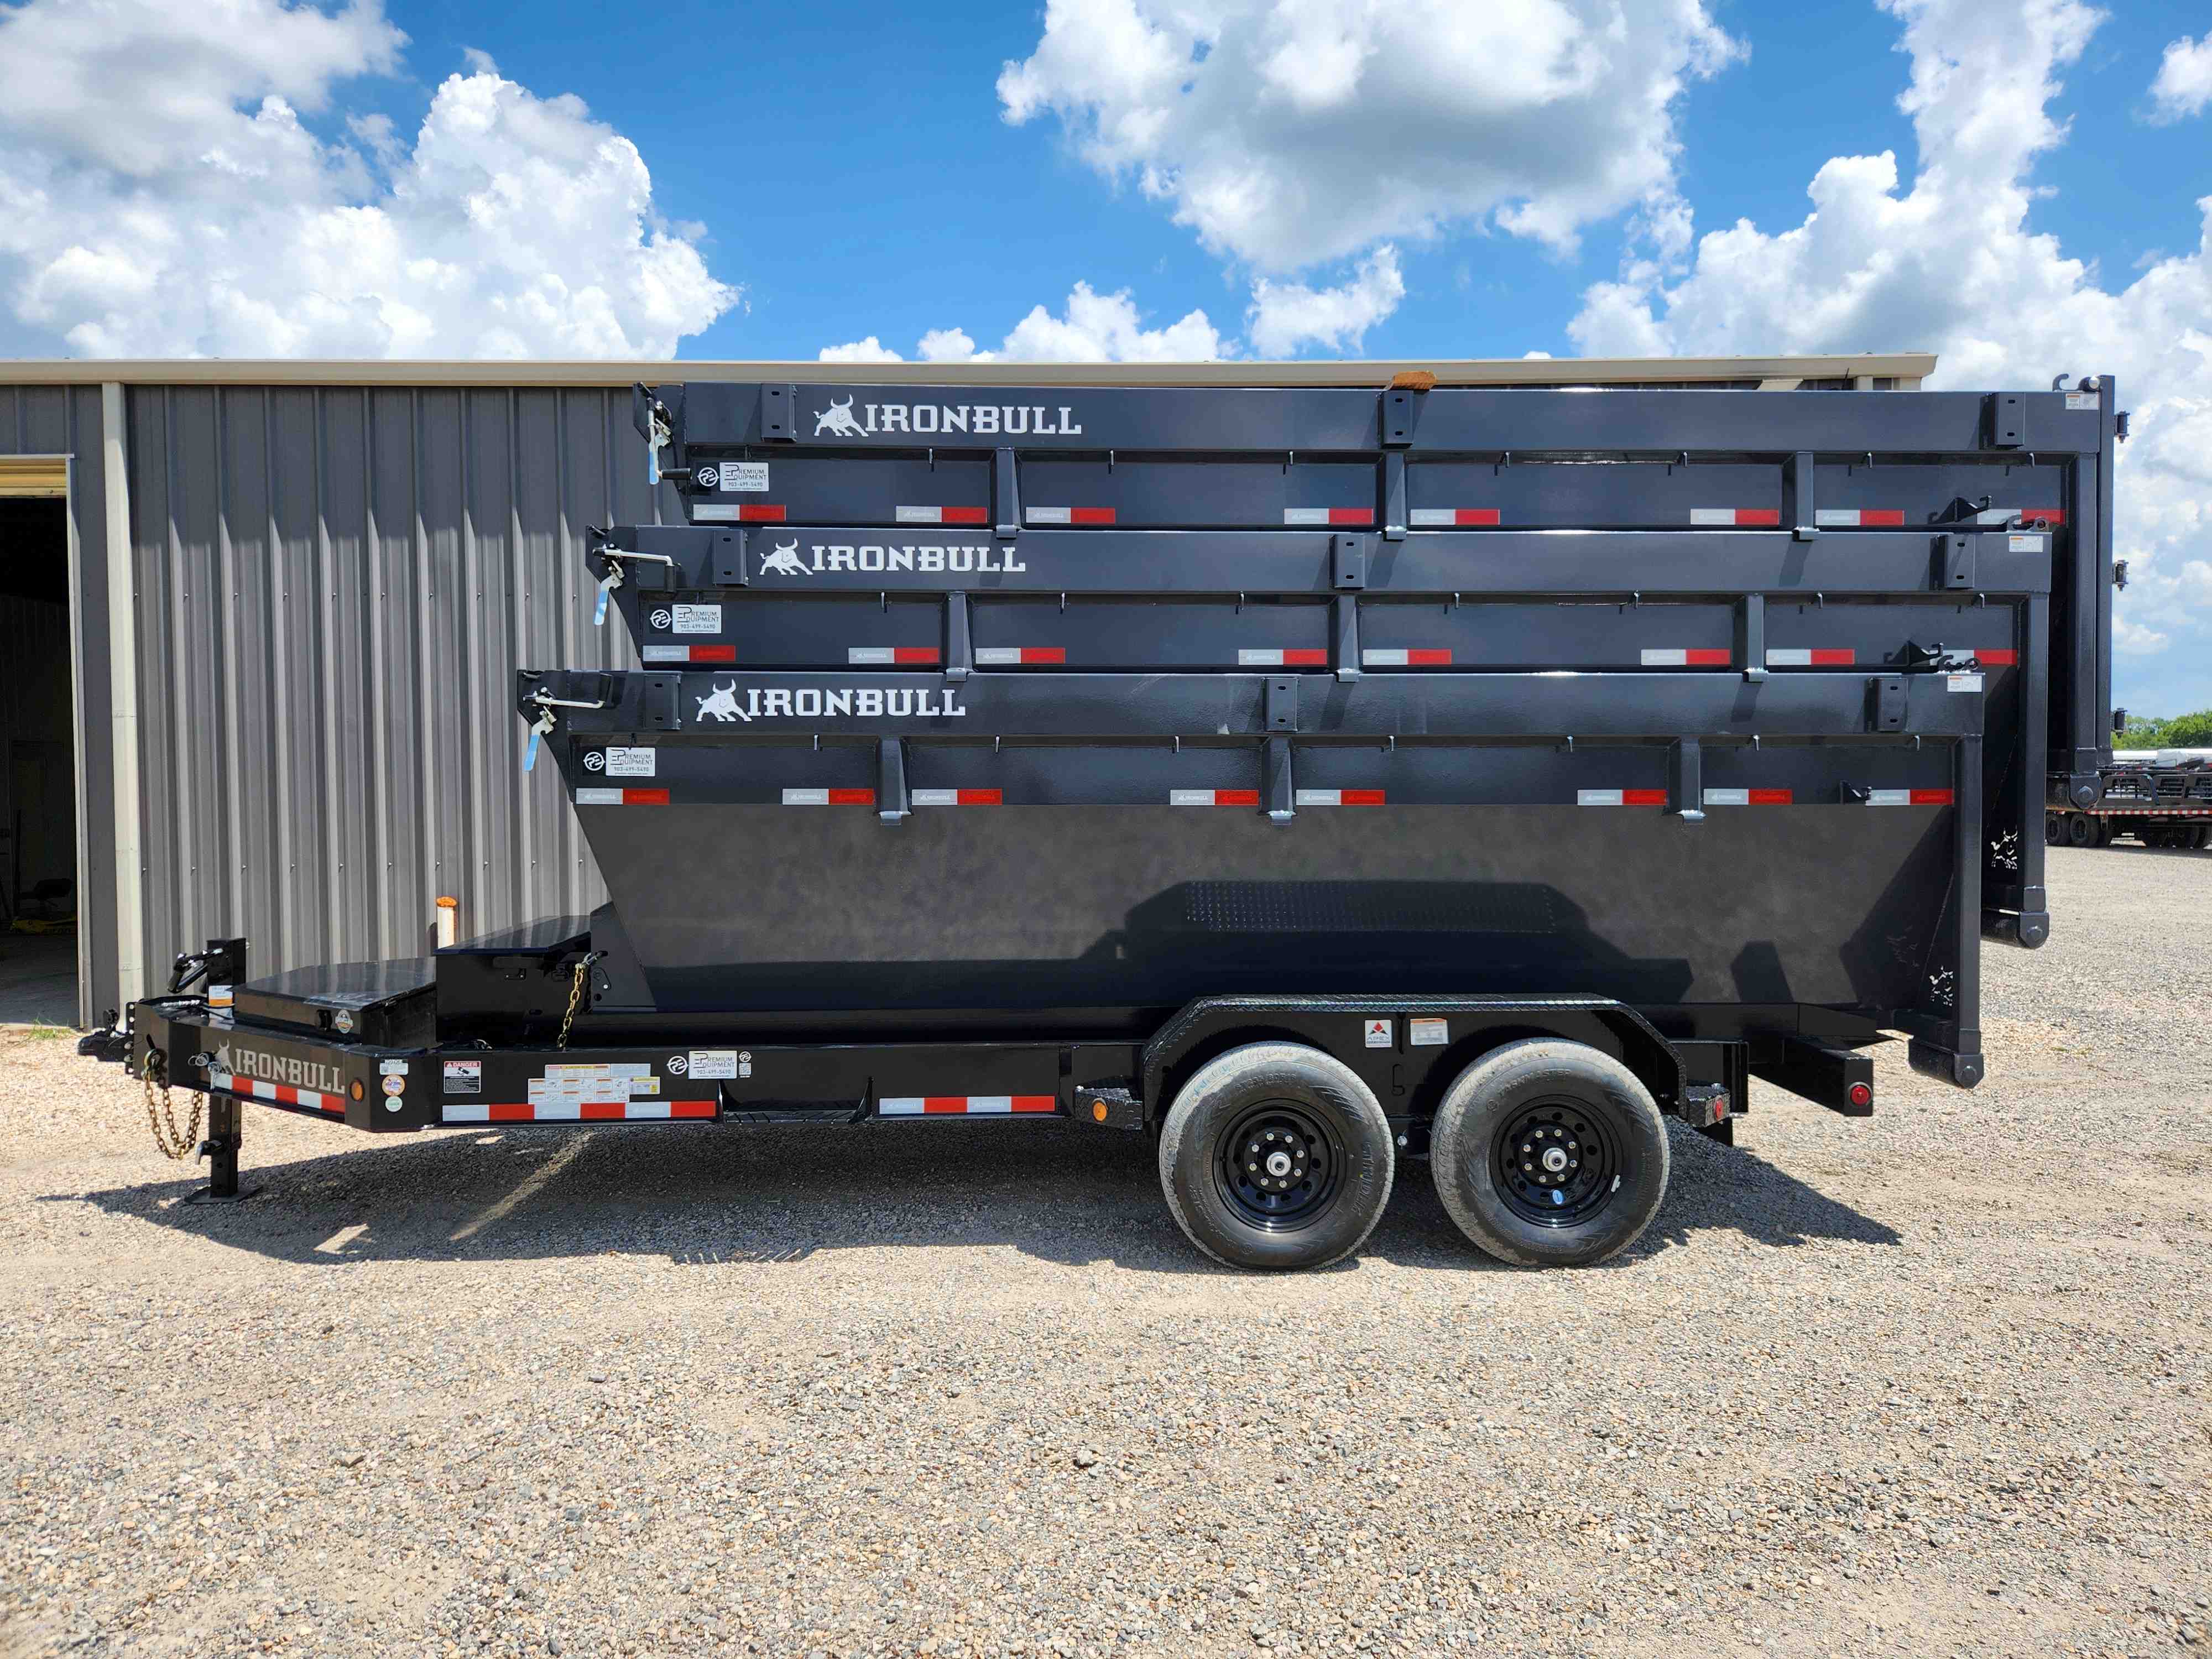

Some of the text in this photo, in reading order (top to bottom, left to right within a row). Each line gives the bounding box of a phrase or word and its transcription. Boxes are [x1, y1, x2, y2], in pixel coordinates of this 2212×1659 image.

[865, 404, 1082, 434] IRONBULL
[724, 464, 764, 476] PREMIUM
[811, 545, 1026, 572] IRONBULL
[677, 606, 717, 618] PREMIUM
[747, 688, 966, 716] IRONBULL
[611, 749, 651, 760] PREMIUM
[693, 1052, 733, 1062] PREMIUM
[235, 1048, 345, 1094] IRONBULL
